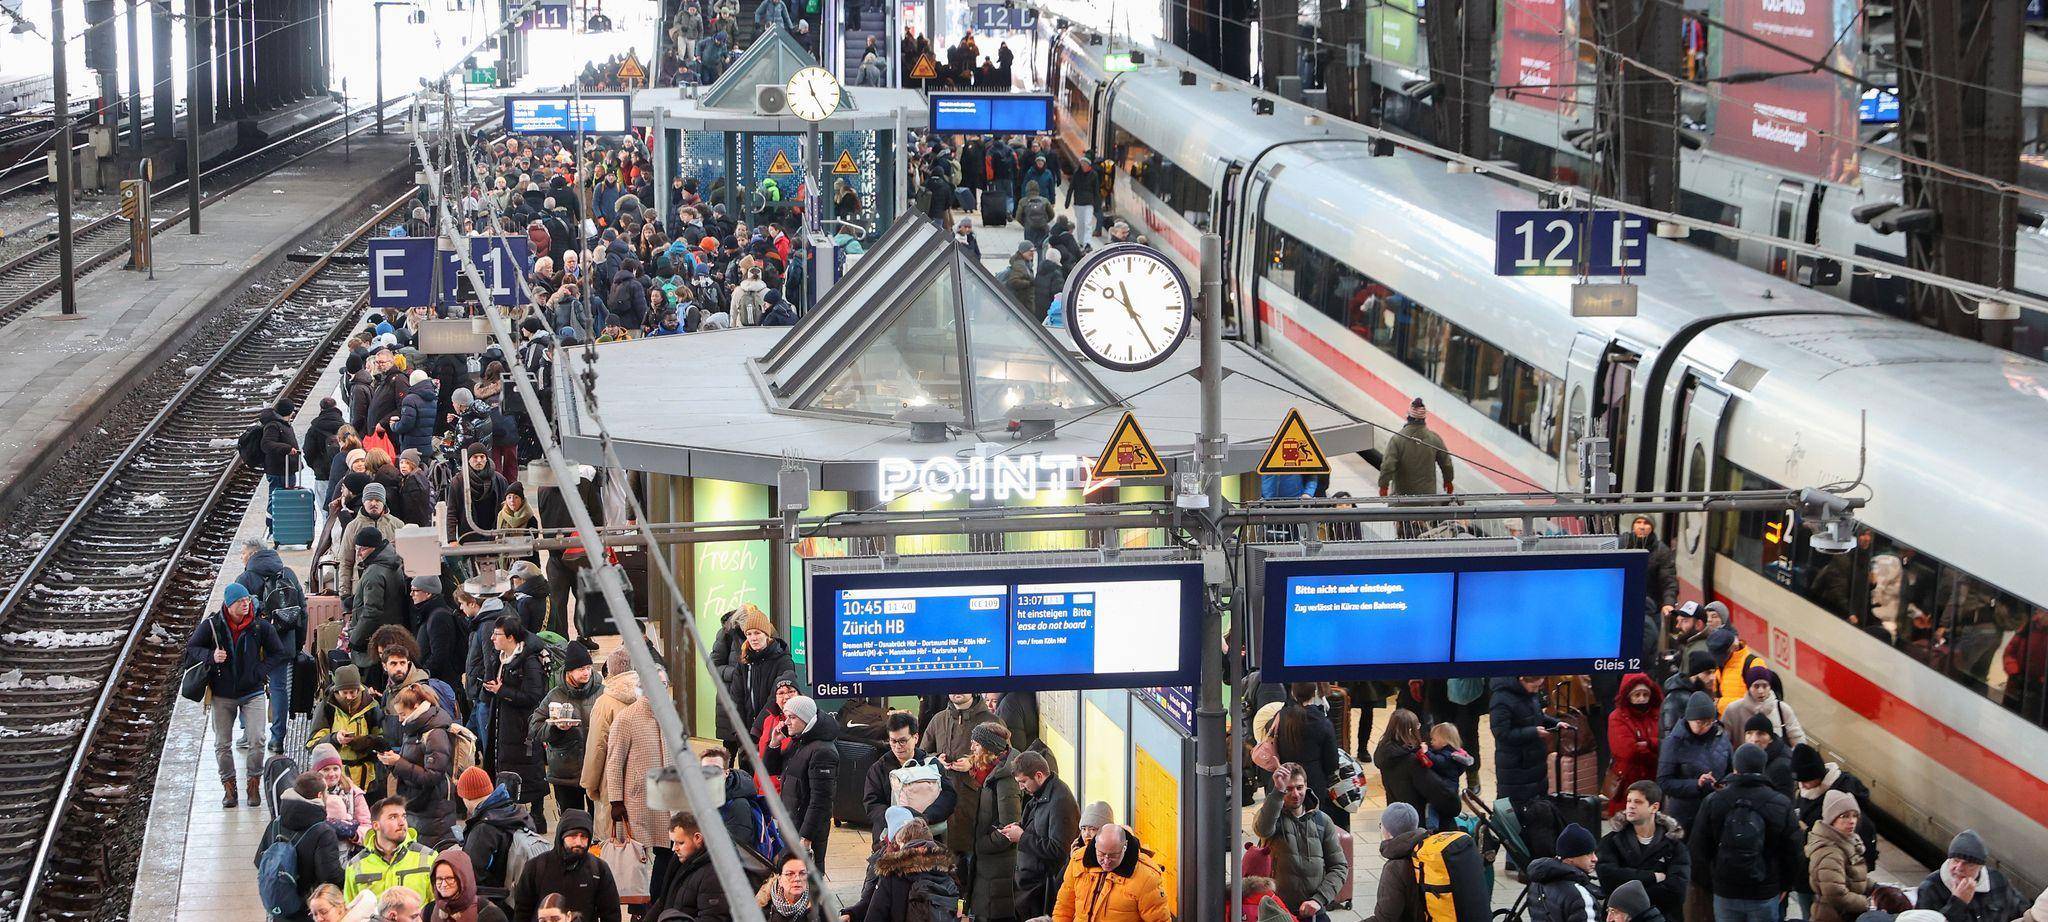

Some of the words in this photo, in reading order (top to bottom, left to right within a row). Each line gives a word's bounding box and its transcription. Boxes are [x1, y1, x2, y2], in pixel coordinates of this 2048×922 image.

[538, 8, 561, 28] 11
[984, 7, 1008, 27] 12
[1515, 219, 1574, 267] 12
[1612, 220, 1641, 267] E
[376, 249, 407, 298] E
[879, 454, 1078, 501] POINT
[1783, 509, 1795, 544] 2
[699, 541, 758, 574] Fresh
[1295, 585, 1315, 594] Bitte
[1317, 585, 1337, 594] nicht
[1338, 584, 1359, 593] mehr
[1360, 583, 1404, 594] einsteigen.
[704, 580, 756, 619] Fast
[985, 599, 998, 607] 109
[1018, 596, 1042, 605] 13:07
[843, 601, 882, 615] 10:45
[1028, 608, 1068, 619] einsteigen
[1073, 607, 1091, 617] Bitte
[1294, 604, 1307, 613] Zug
[1308, 603, 1333, 611] verlässt
[1341, 602, 1359, 610] Kürze
[1360, 602, 1372, 610] den
[1374, 601, 1408, 611] Bahnsteig.
[842, 620, 882, 635] Zürich
[886, 619, 904, 634] HB
[1038, 621, 1047, 630] do
[1049, 621, 1063, 629] not
[1063, 620, 1086, 629] board
[864, 641, 873, 649] Hbf
[1594, 659, 1625, 670] Gleis
[1628, 658, 1640, 670] 12
[817, 684, 849, 695] Gleis
[852, 683, 863, 694] 11
